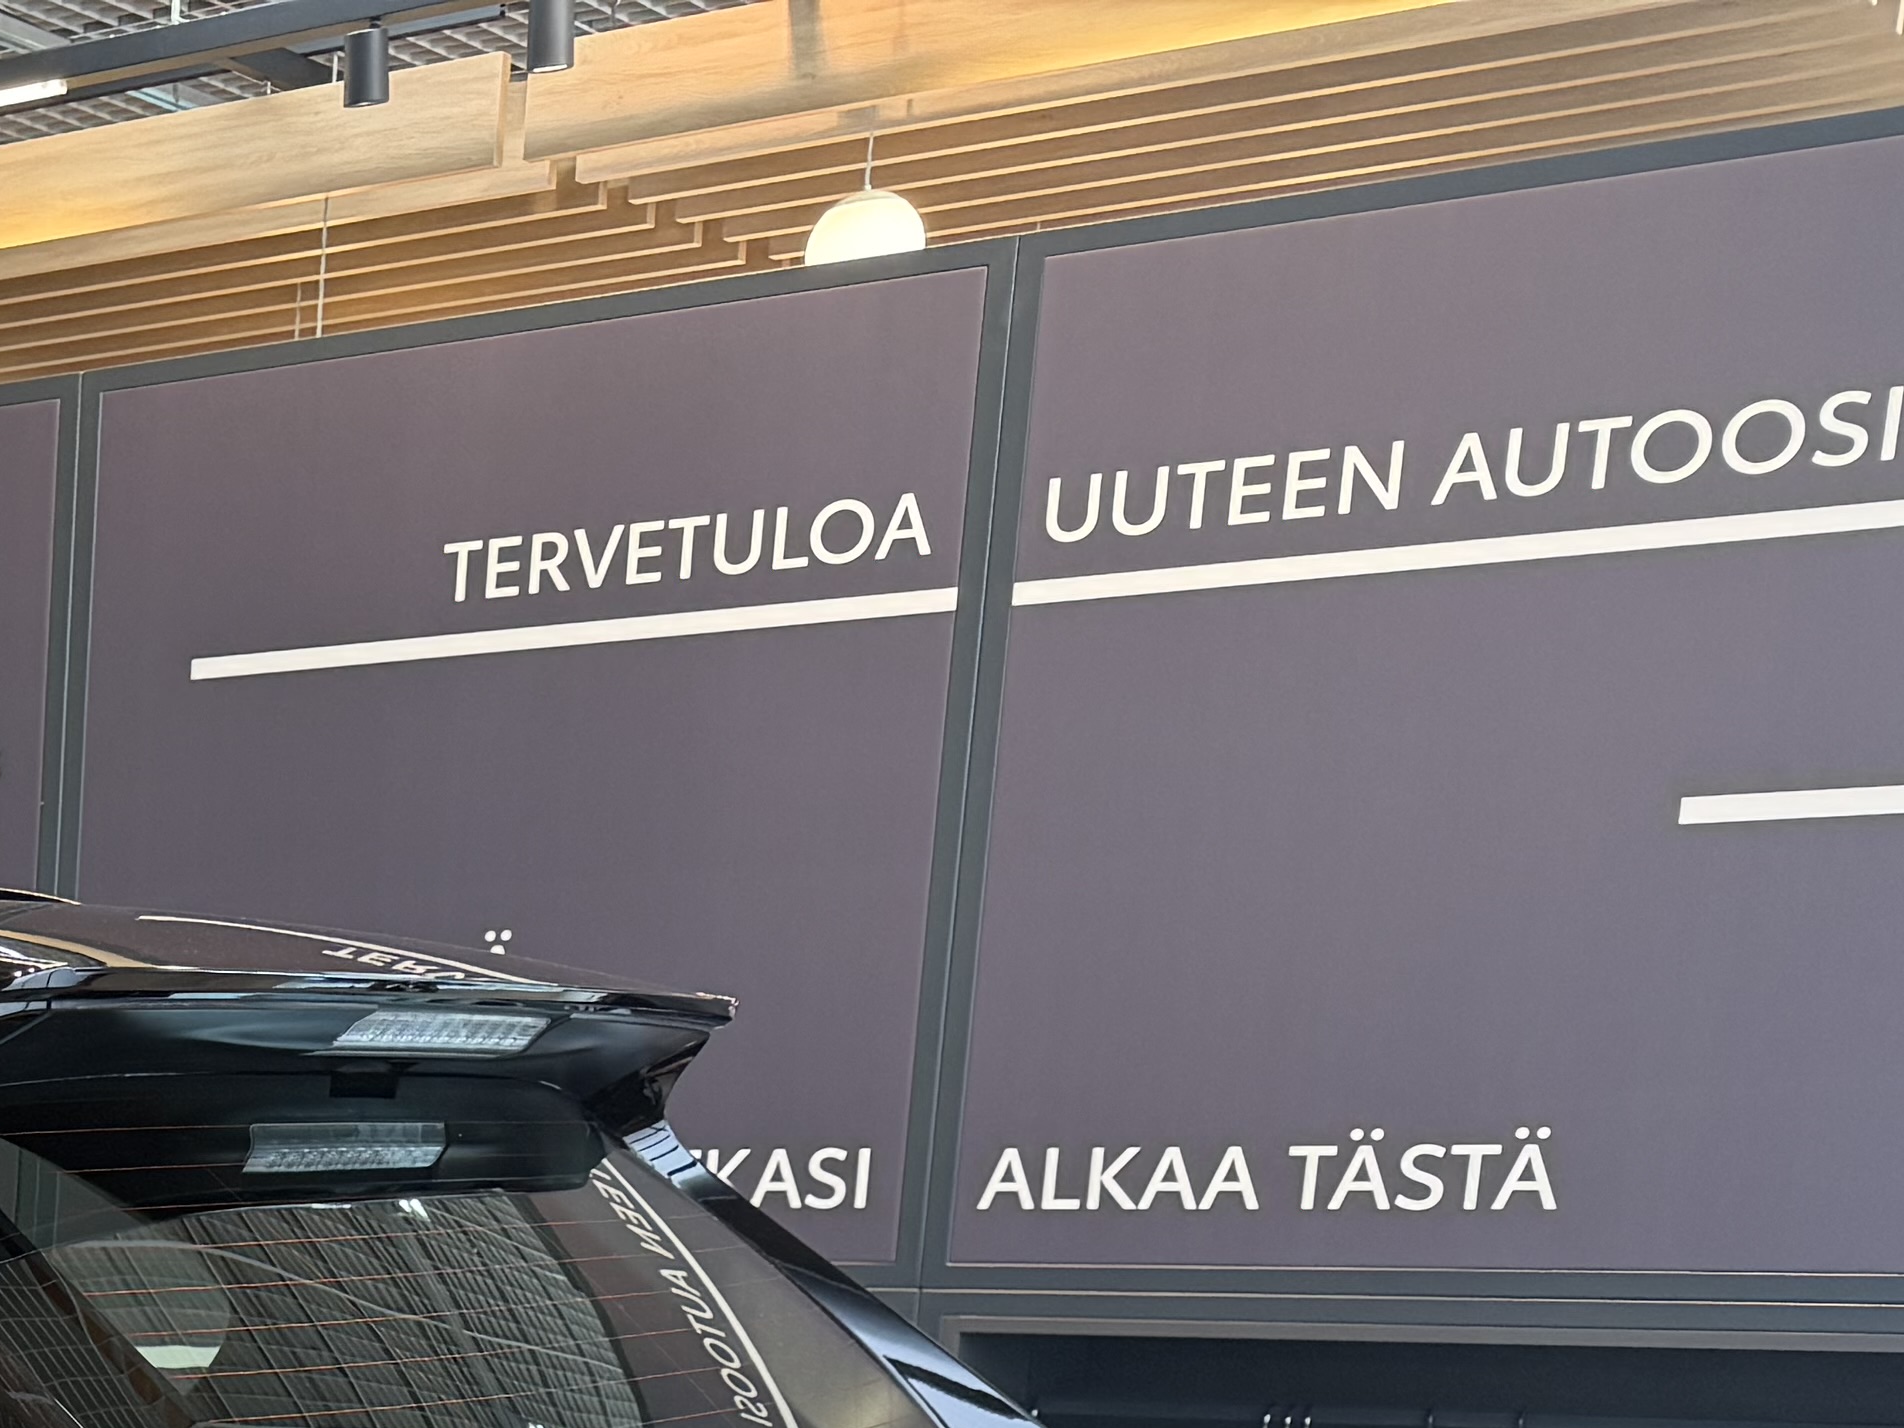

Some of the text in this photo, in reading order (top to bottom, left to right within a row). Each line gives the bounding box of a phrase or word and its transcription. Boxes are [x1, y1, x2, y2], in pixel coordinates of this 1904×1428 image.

[1045, 386, 1904, 543] UUTEEN AUTOOSI
[443, 492, 932, 602] TERVETULOA
[690, 1147, 872, 1209] KASI
[976, 1126, 1557, 1211] ALKAA TÄSTÄ
